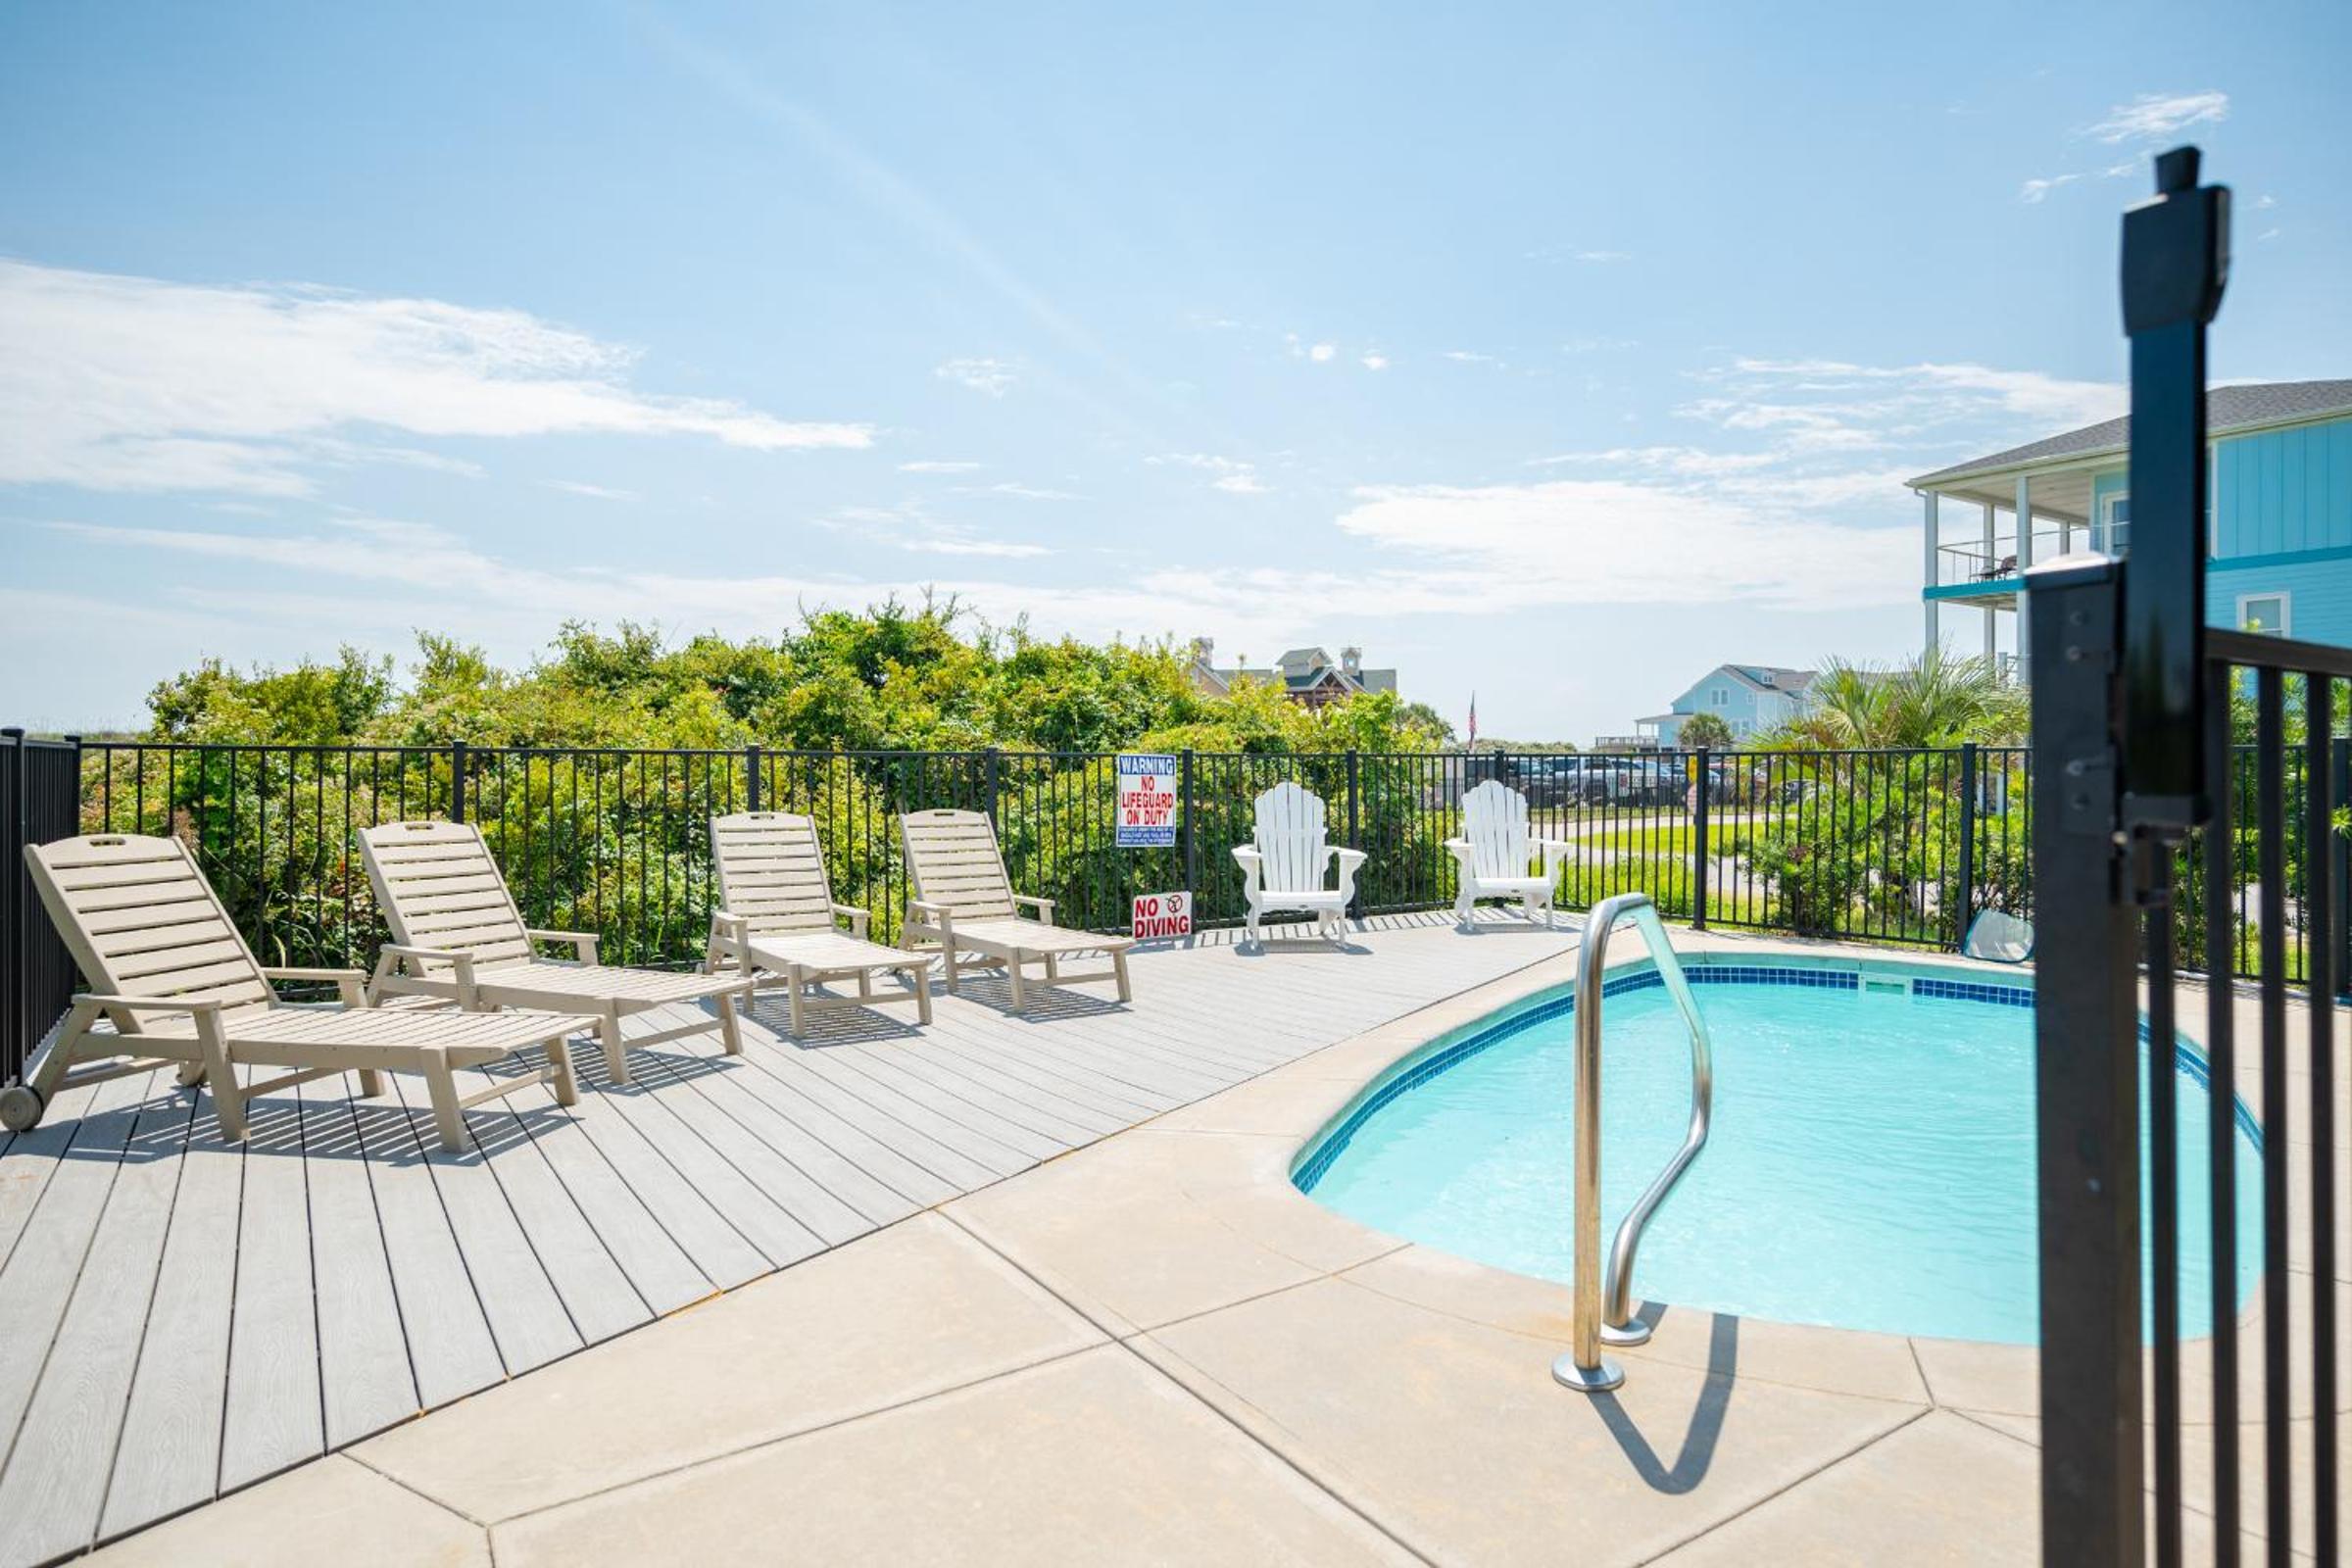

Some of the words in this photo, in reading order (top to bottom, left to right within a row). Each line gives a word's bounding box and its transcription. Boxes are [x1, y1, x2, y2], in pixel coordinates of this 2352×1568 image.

[1121, 758, 1173, 774] WARNING
[1141, 775, 1155, 791] NO
[1122, 792, 1173, 808] LIFEGUARD
[1126, 808, 1139, 825] ON
[1144, 808, 1168, 825] DUTY
[1135, 898, 1158, 917] NO
[1135, 915, 1189, 939] DIVING
